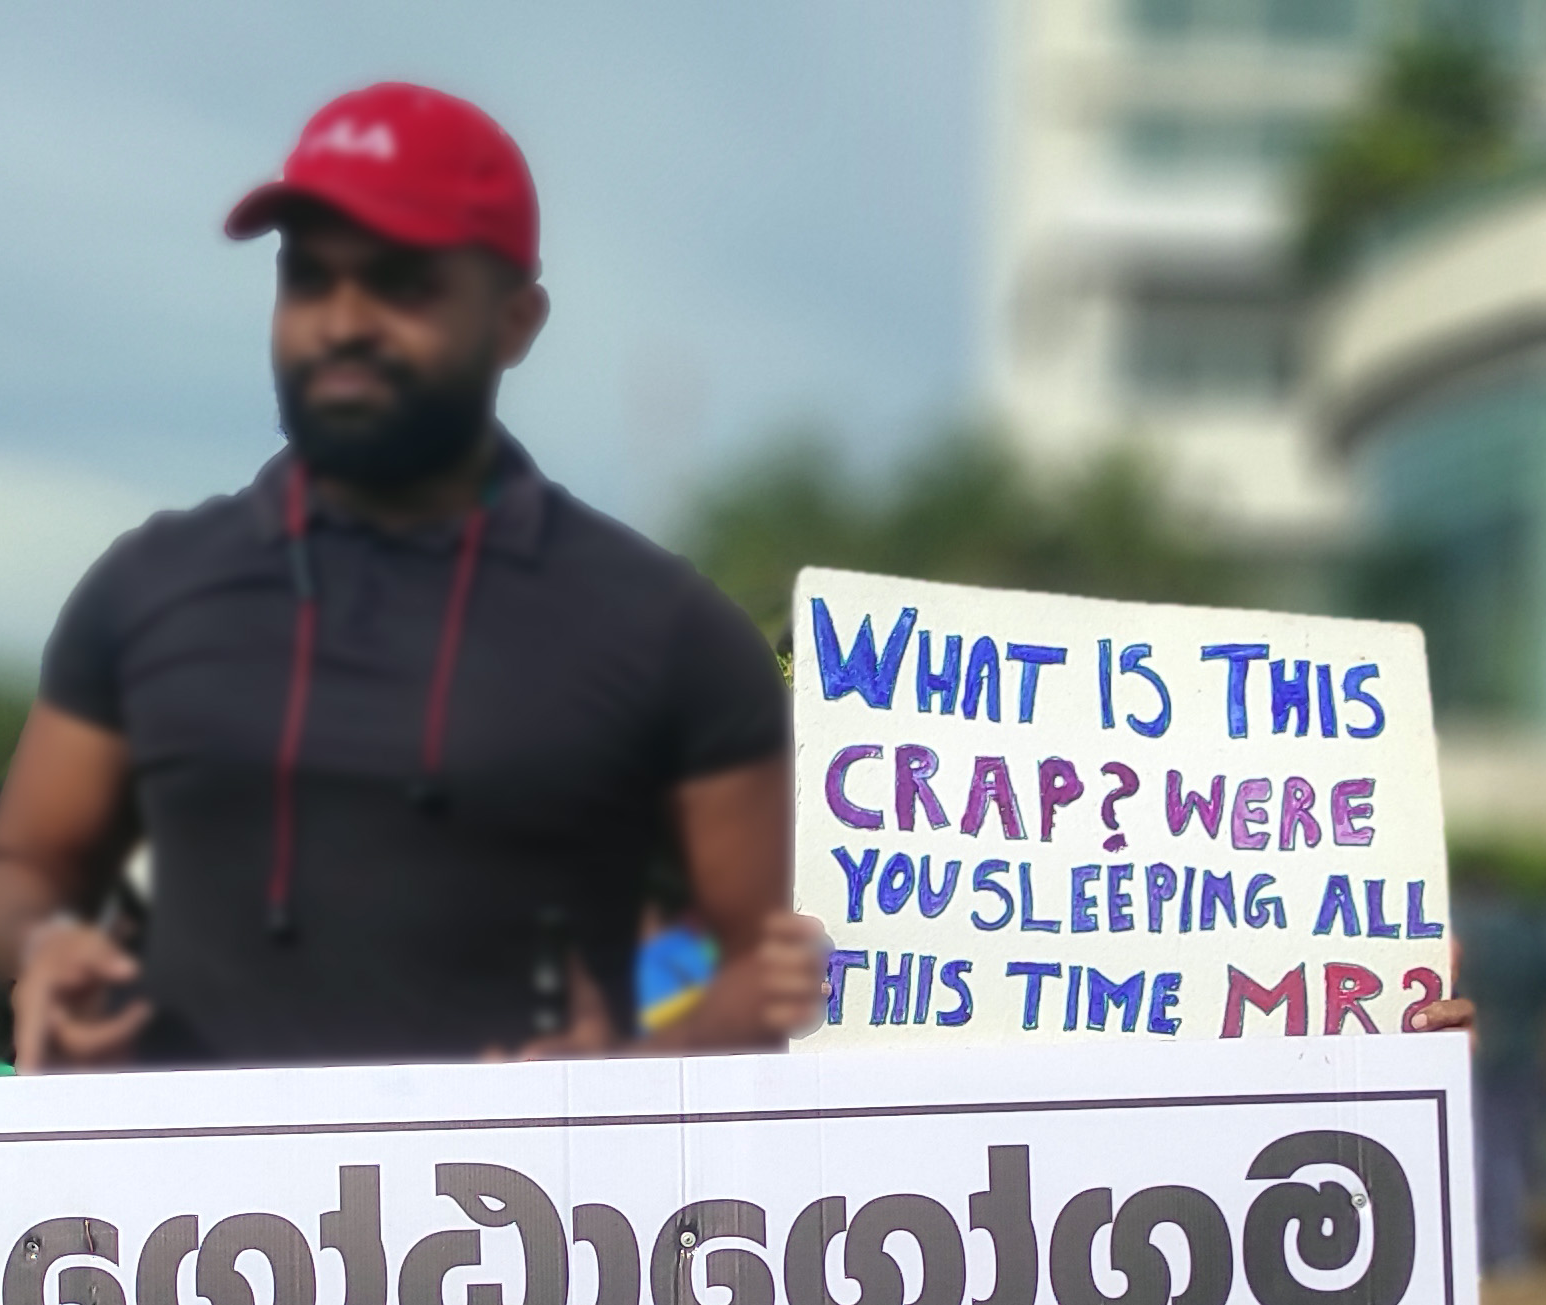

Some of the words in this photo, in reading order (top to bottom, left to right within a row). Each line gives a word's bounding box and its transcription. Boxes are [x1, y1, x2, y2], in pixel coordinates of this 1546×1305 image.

[810, 597, 1067, 723] WHAT
[1098, 639, 1171, 737] IS
[1201, 644, 1384, 738] THIS
[825, 744, 1139, 853] CRAP?
[1167, 770, 1375, 850] WERE
[1313, 875, 1443, 939] ALL
[826, 950, 973, 1026] THIS
[1006, 962, 1182, 1035] TIME
